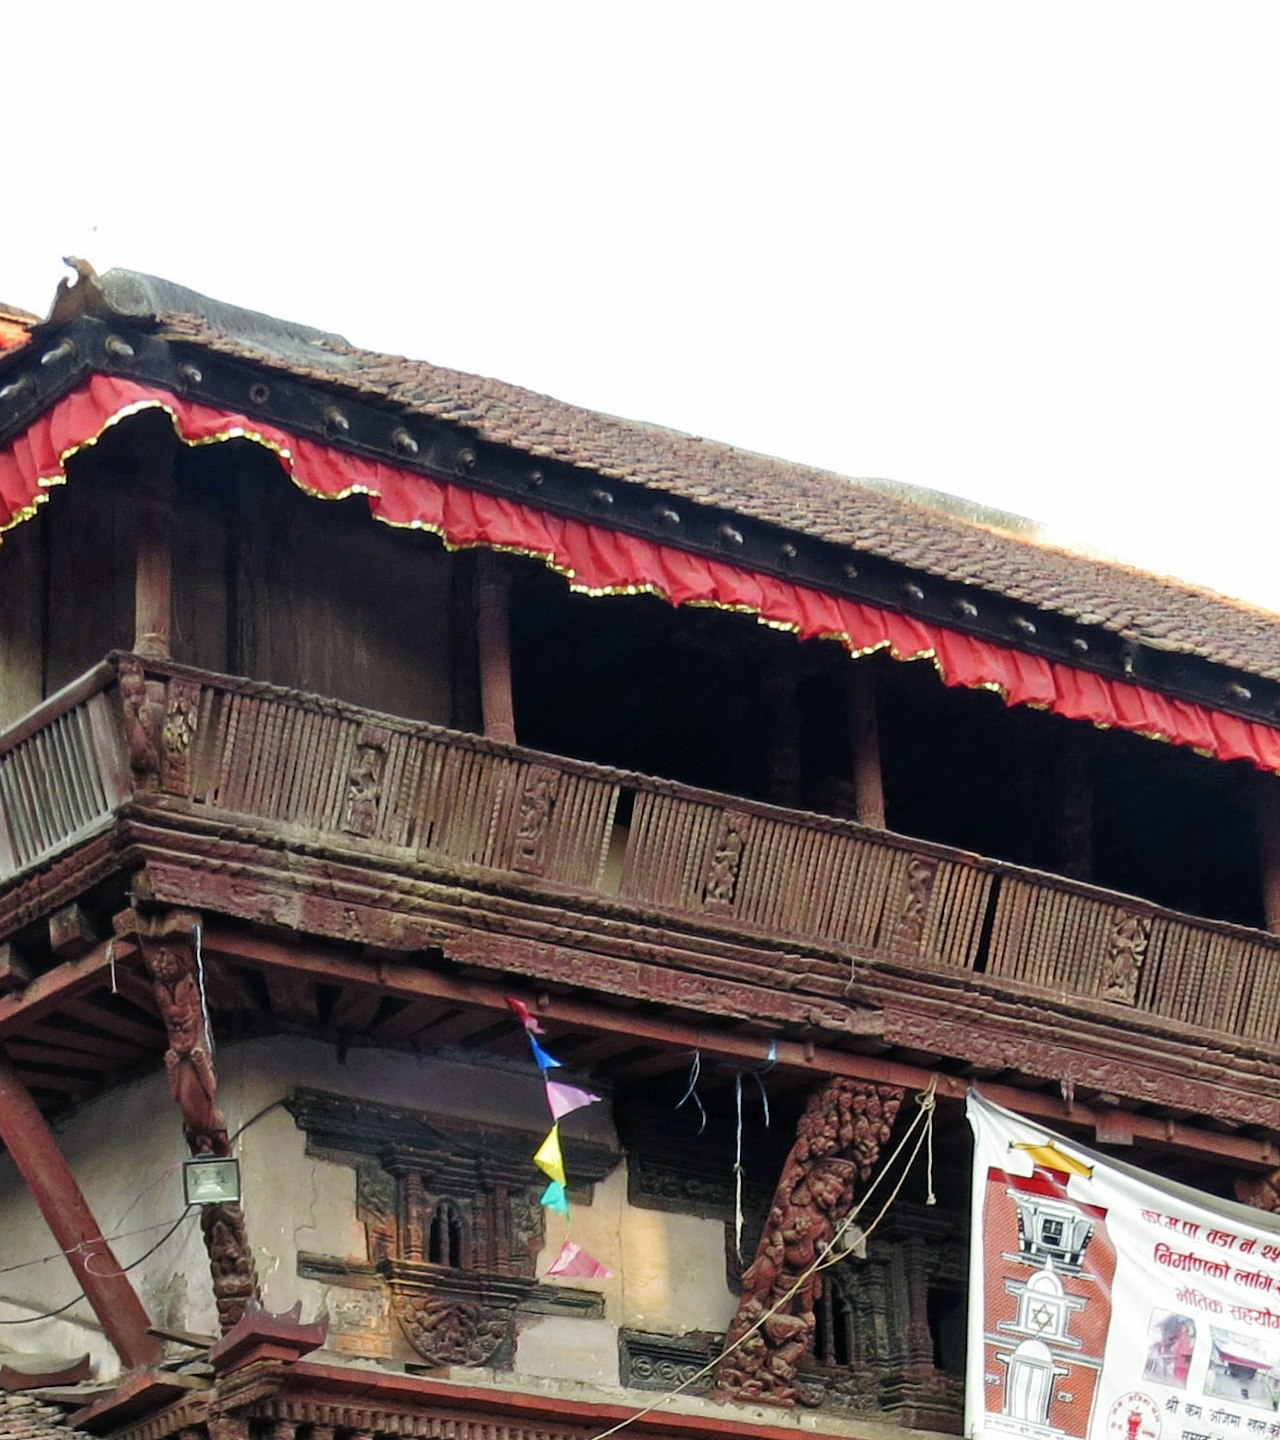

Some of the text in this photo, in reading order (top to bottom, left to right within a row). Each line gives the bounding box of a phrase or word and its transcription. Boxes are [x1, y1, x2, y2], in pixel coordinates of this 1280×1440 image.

[1206, 1228, 1238, 1249] वडा
[1153, 1241, 1231, 1281] निर्माणको
[1233, 1268, 1274, 1292] लागि
[1175, 1285, 1223, 1315] भौतिक
